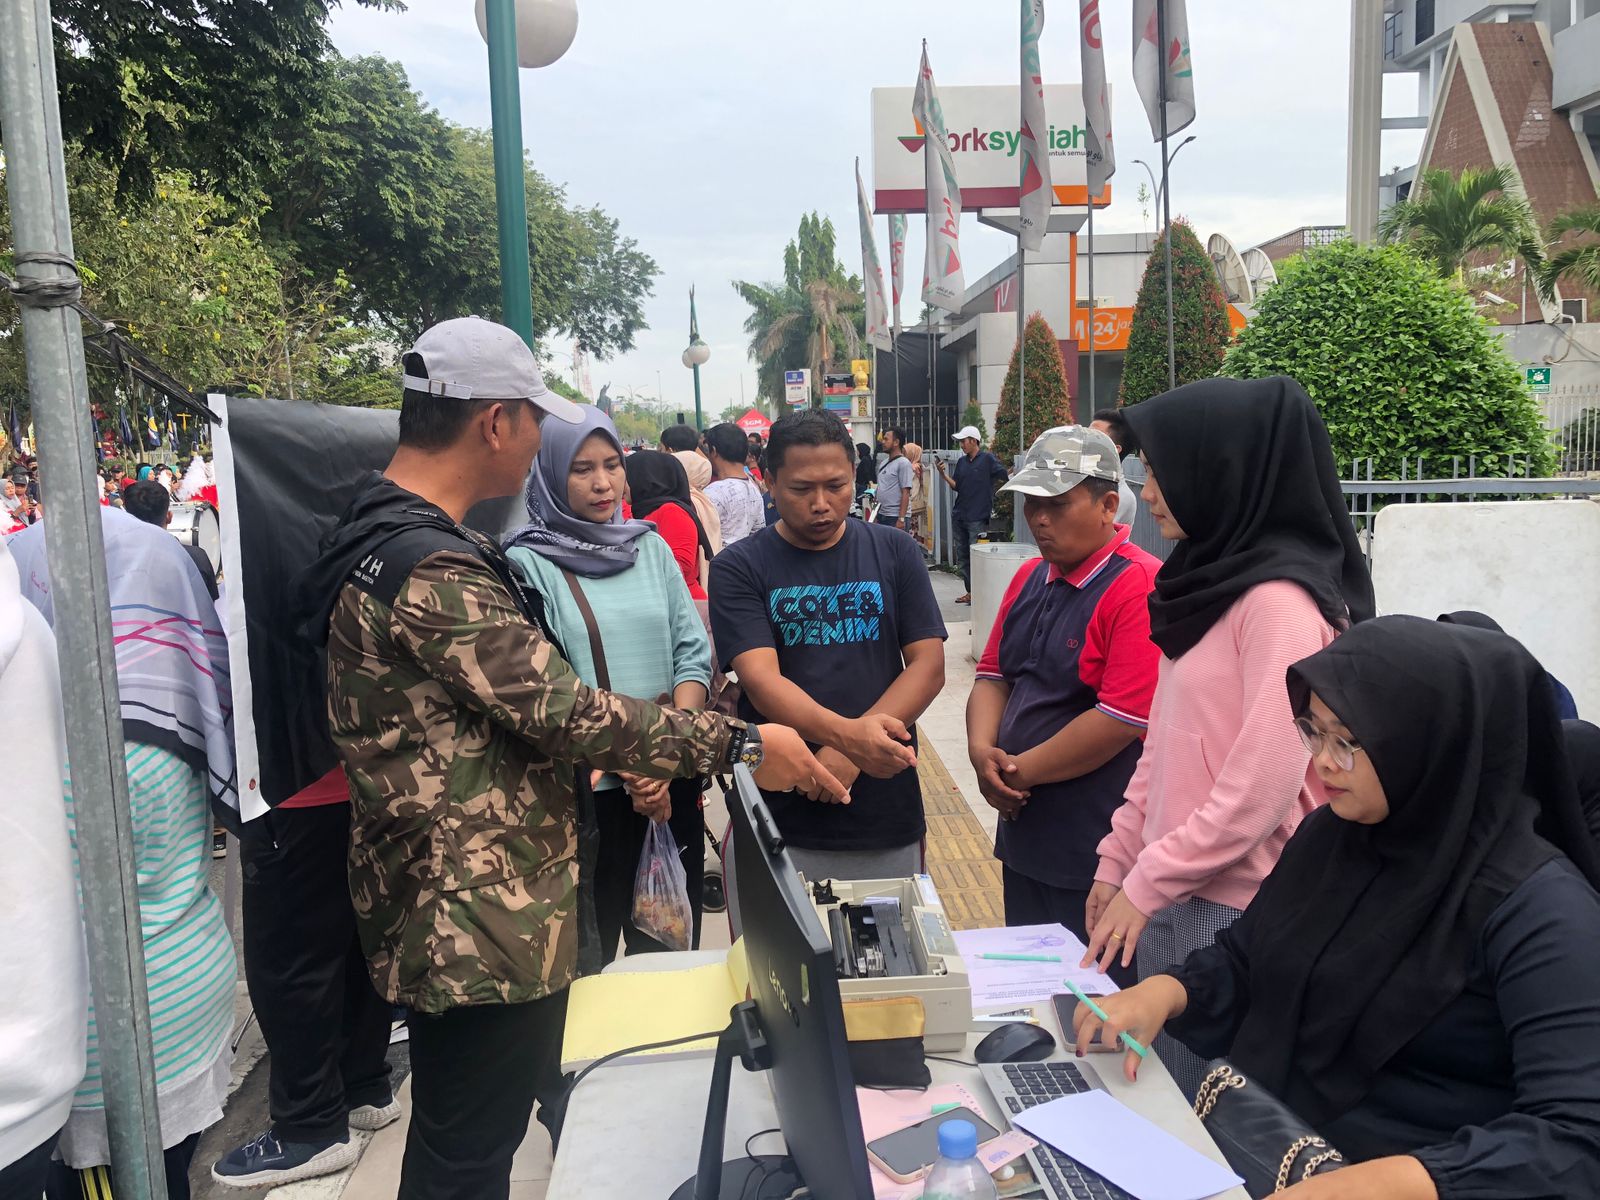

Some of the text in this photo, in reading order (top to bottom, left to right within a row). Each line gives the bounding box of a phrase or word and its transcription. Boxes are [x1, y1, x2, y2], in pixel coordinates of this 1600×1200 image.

[1093, 321, 1114, 336] 24
[780, 616, 882, 647] DENIM
[768, 953, 801, 1029] Lenovo
